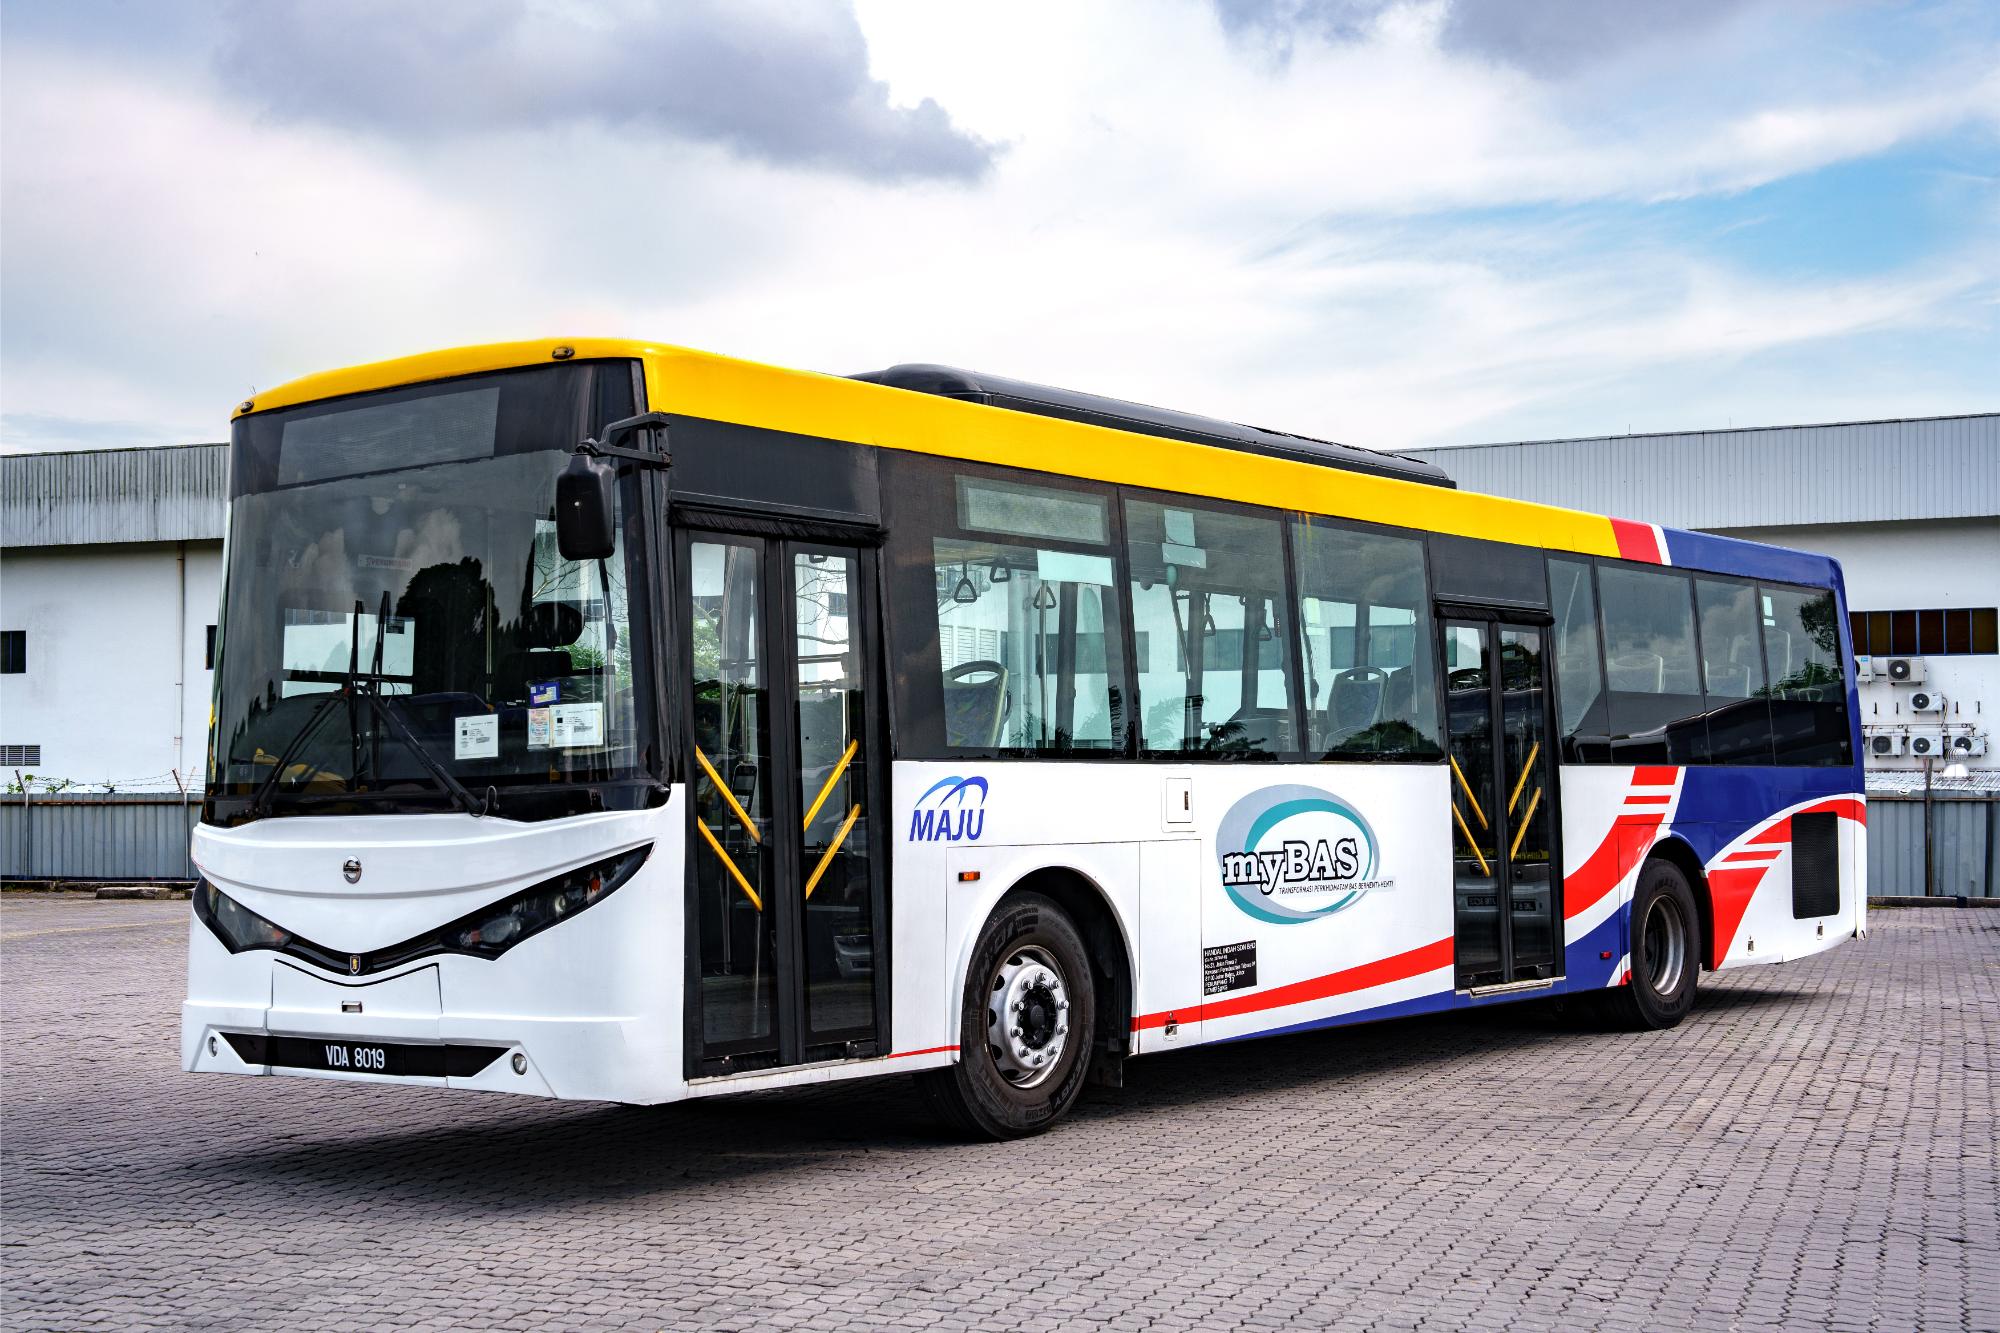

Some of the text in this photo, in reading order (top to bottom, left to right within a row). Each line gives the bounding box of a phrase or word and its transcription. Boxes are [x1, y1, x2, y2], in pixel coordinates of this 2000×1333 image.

[909, 809, 984, 841] MAJU
[1222, 838, 1358, 895] myBAS
[1279, 885, 1314, 895] TRANSFORMASI
[1314, 883, 1348, 892] PERKHIDMATAN
[1349, 882, 1357, 890] BAS
[1205, 949, 1222, 957] HANDAL
[1222, 945, 1237, 954] INDAH
[1246, 942, 1256, 950] BHD
[325, 1045, 385, 1069] VDA 8019
